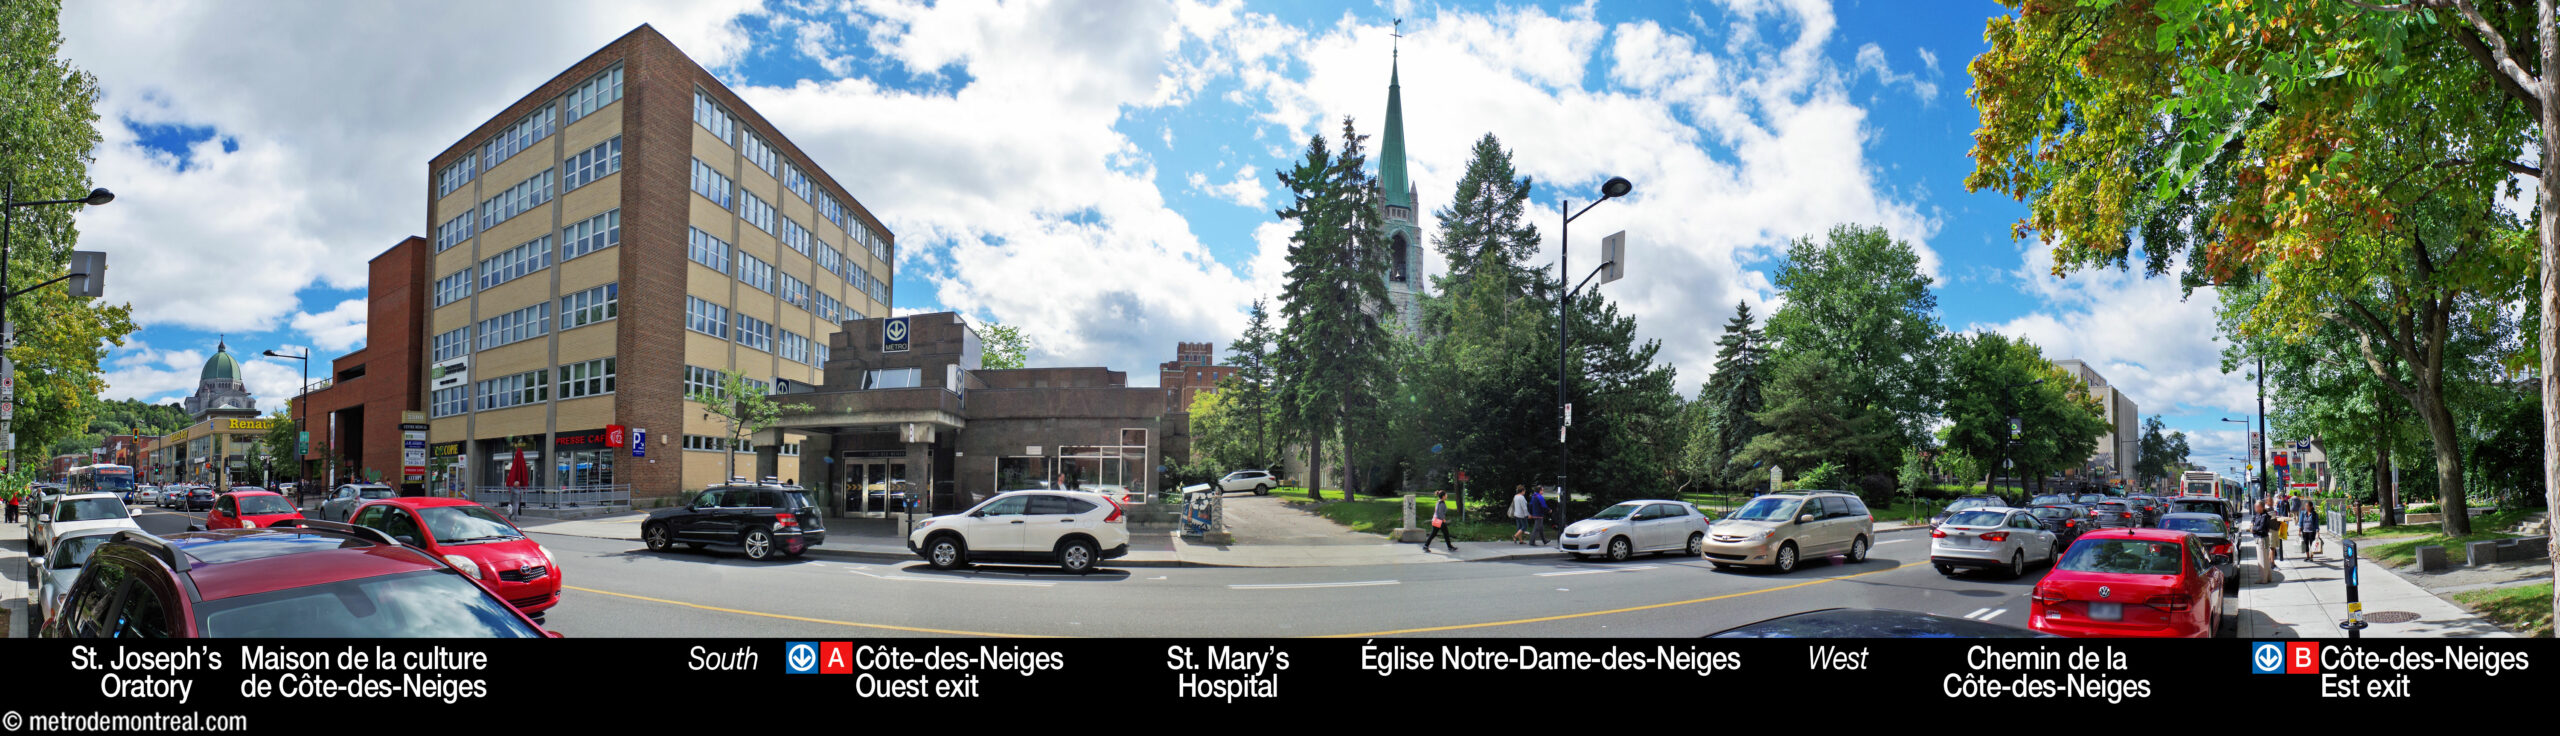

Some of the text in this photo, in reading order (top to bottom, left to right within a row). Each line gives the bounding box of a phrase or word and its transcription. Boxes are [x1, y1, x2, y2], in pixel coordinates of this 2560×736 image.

[228, 418, 274, 430] Renau
[556, 435, 606, 446] PRESSE CAF
[633, 432, 641, 449] P
